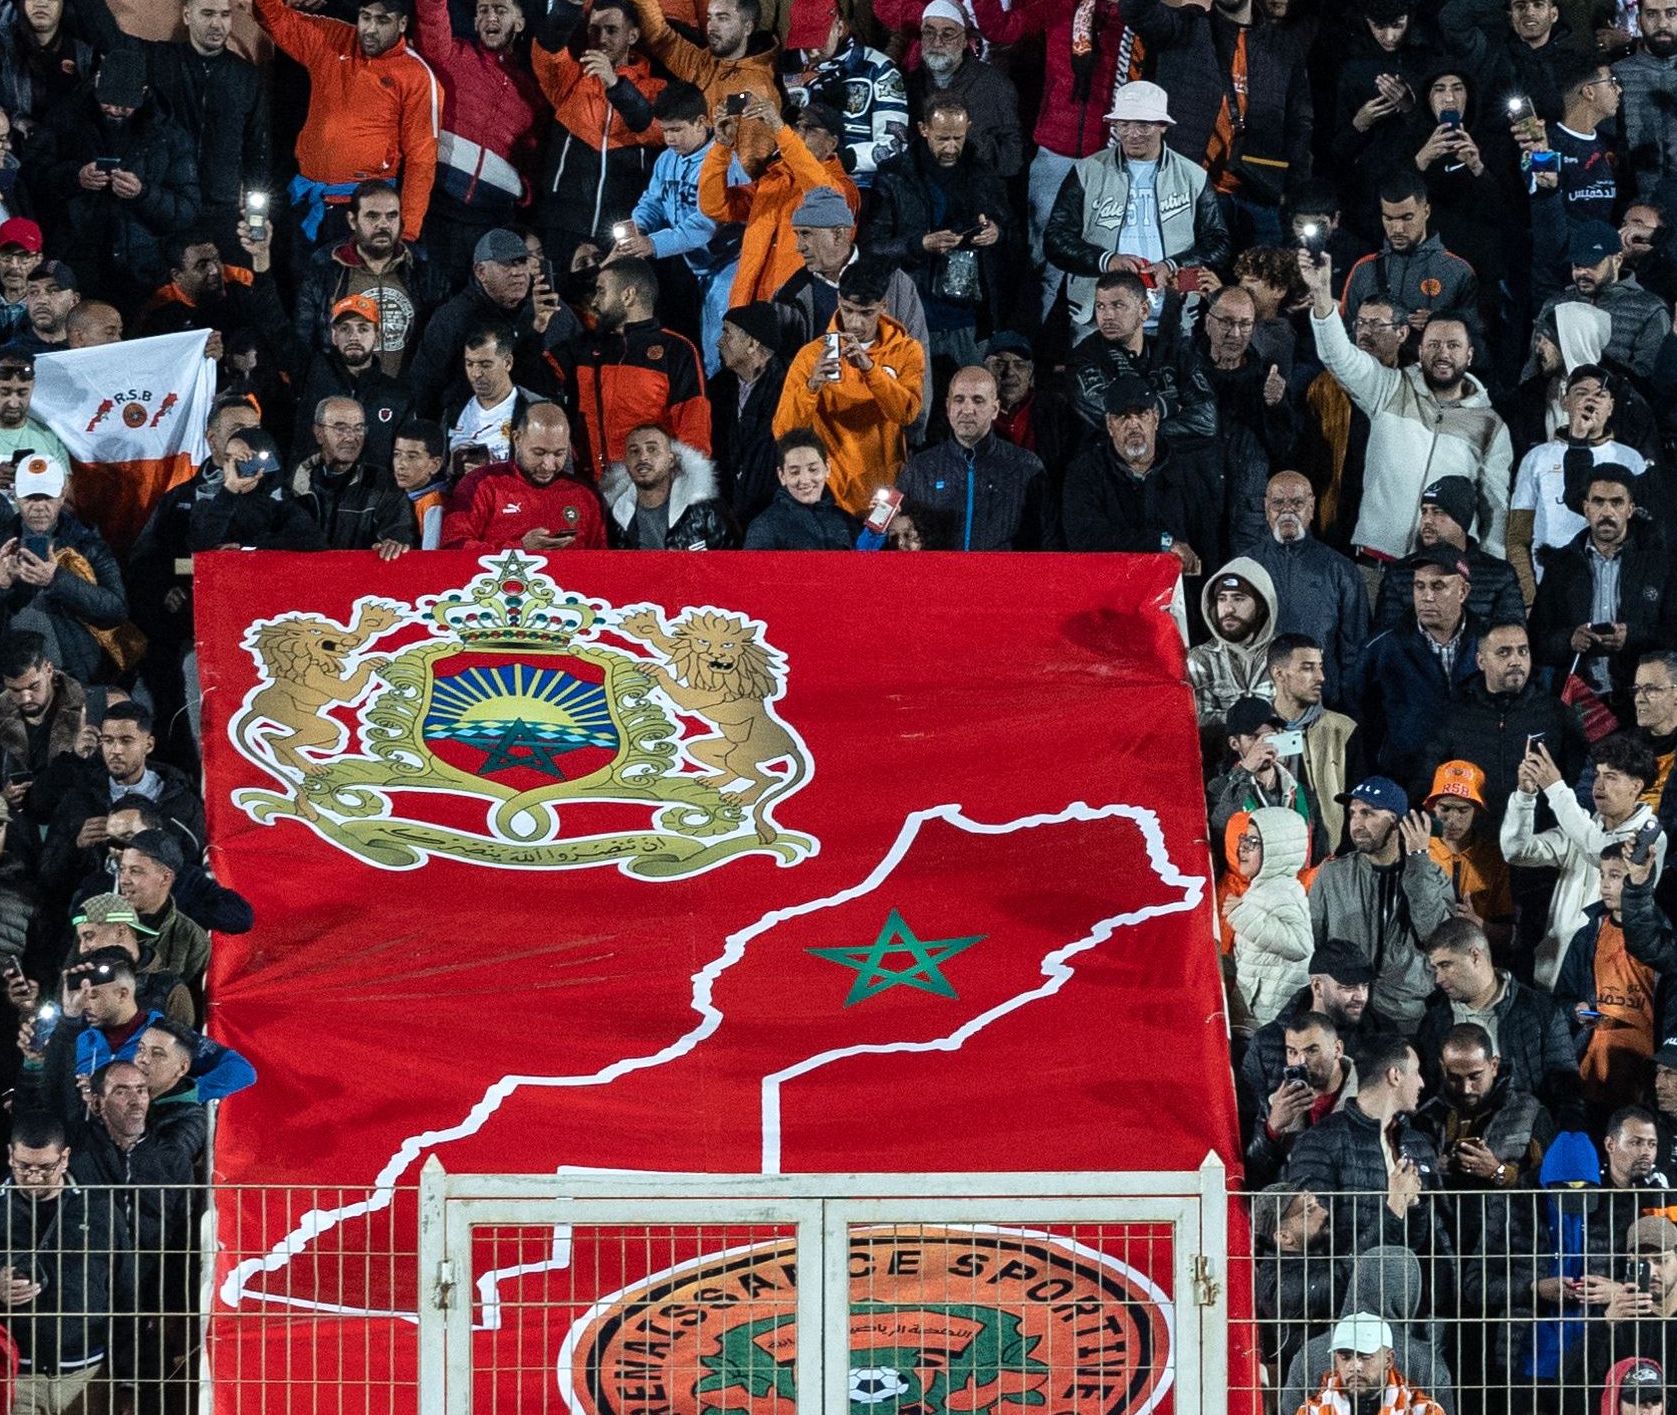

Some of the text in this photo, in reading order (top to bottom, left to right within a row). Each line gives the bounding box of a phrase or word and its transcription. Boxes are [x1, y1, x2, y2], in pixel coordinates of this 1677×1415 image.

[114, 389, 153, 405] R.S.B
[1441, 783, 1470, 800] RSB
[948, 1252, 1126, 1402] SPORTIVE
